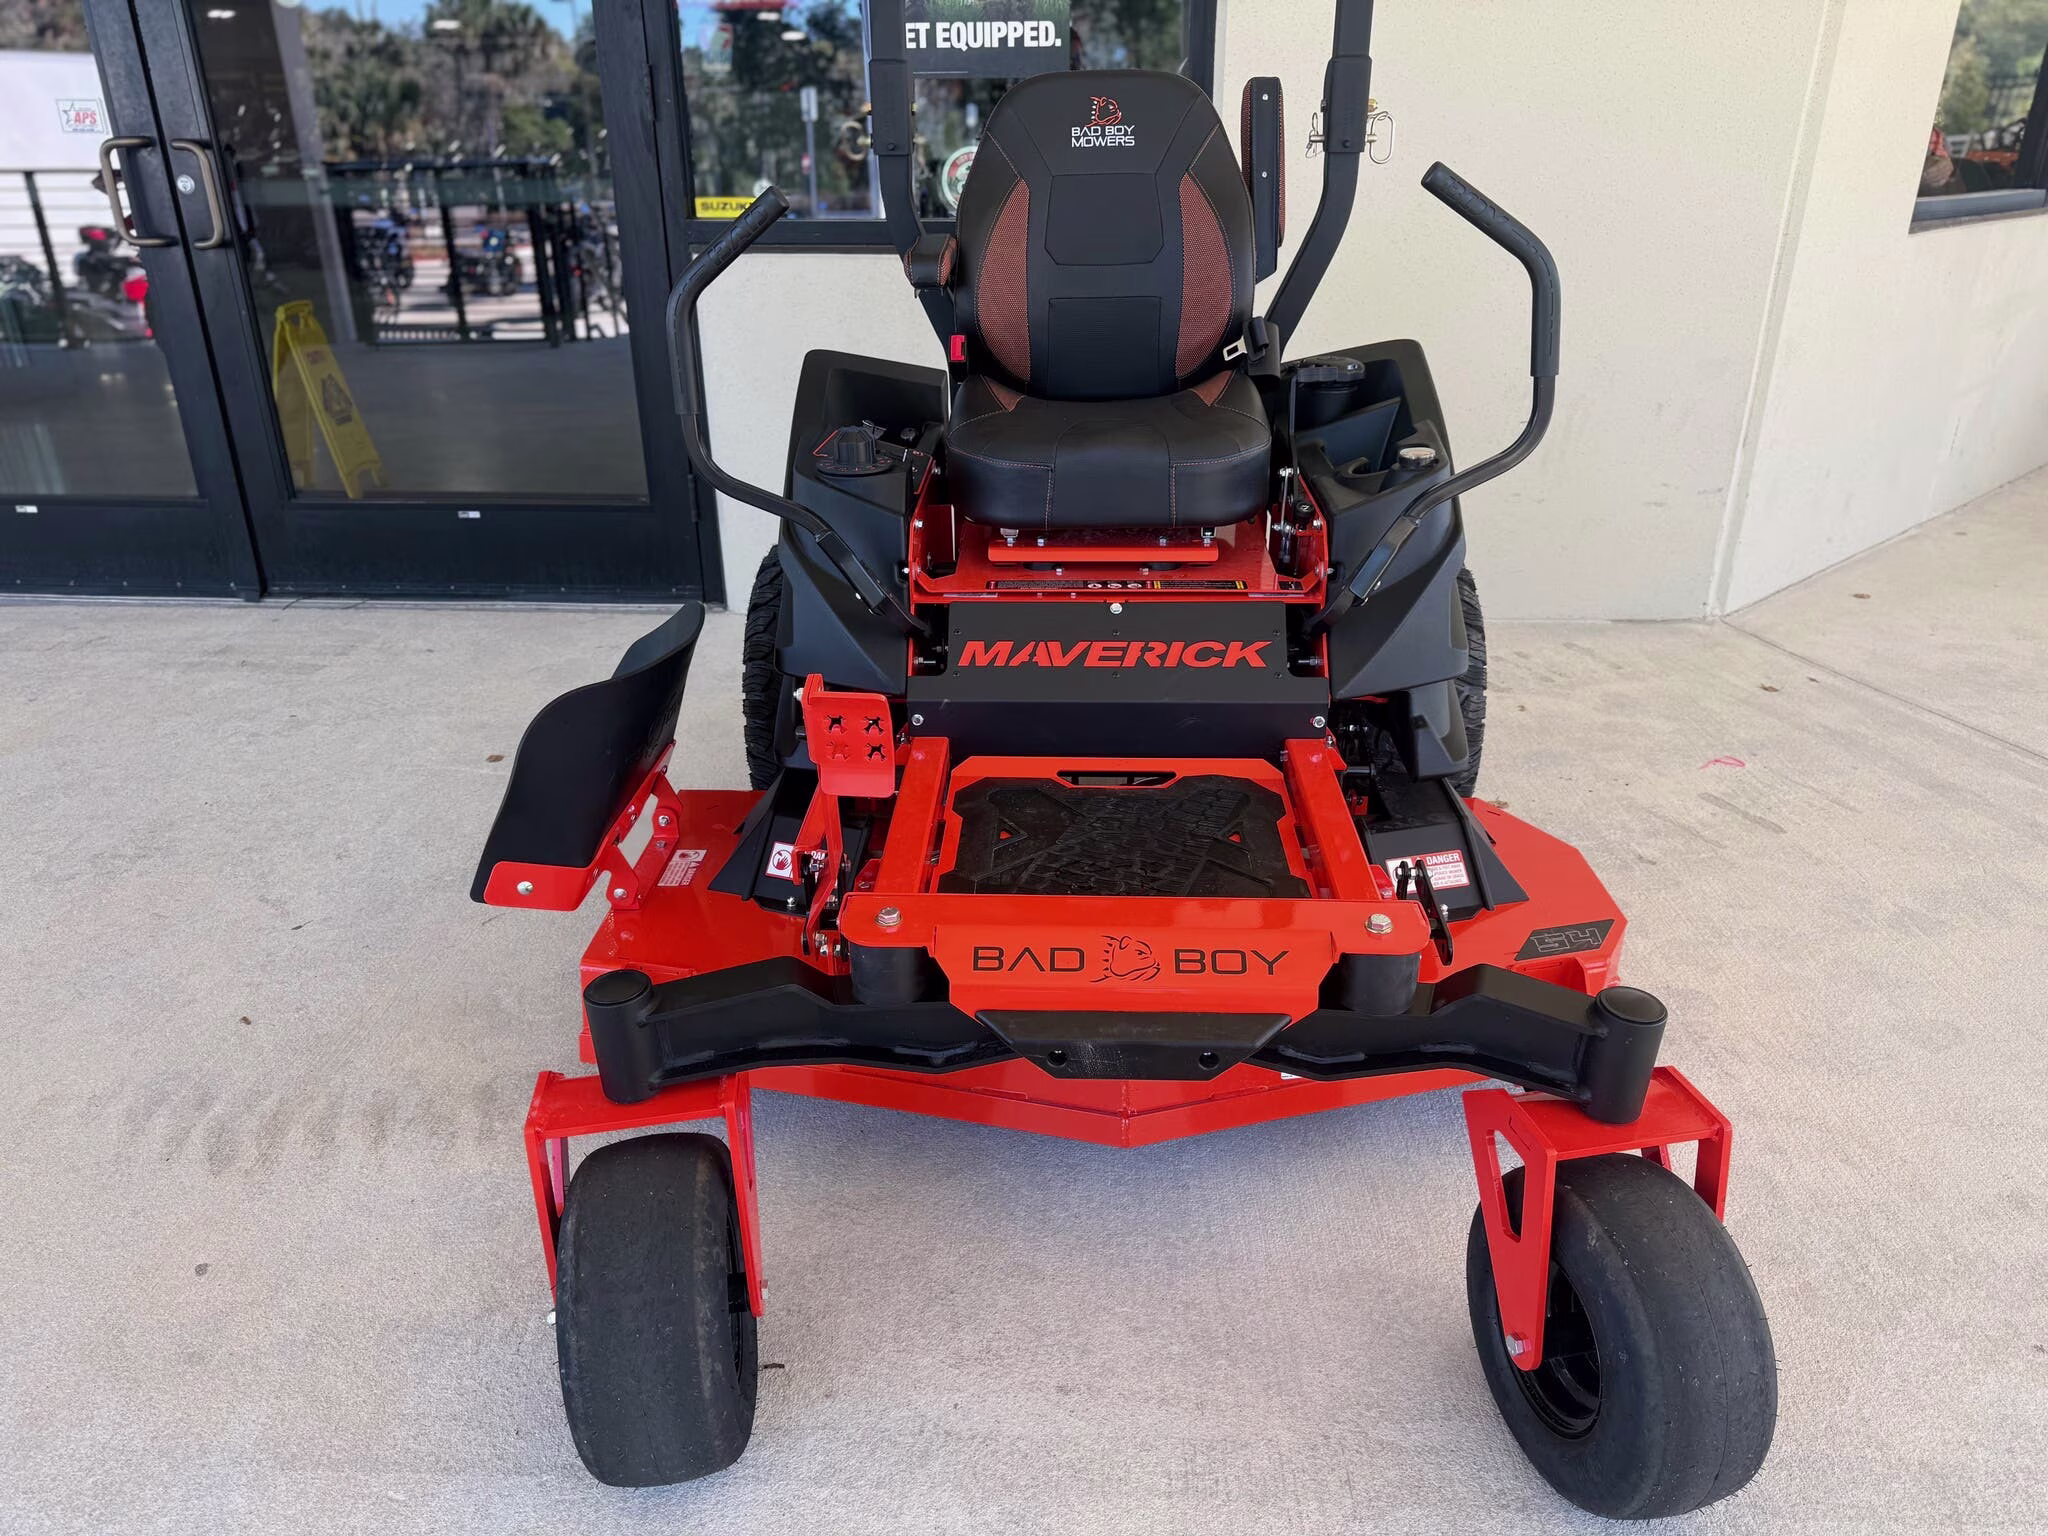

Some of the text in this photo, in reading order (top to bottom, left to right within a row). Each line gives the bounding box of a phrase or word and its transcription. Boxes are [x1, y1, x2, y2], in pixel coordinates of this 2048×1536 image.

[905, 20, 1062, 51] ET EQUIPPED.
[74, 111, 97, 125] APS
[1072, 125, 1135, 136] BAD BOY
[1072, 136, 1135, 147] MOWERS
[957, 640, 1273, 668] MAVERICK
[1426, 853, 1460, 865] DANGER
[1530, 927, 1603, 953] 54
[972, 946, 1289, 975] BAD BOY
